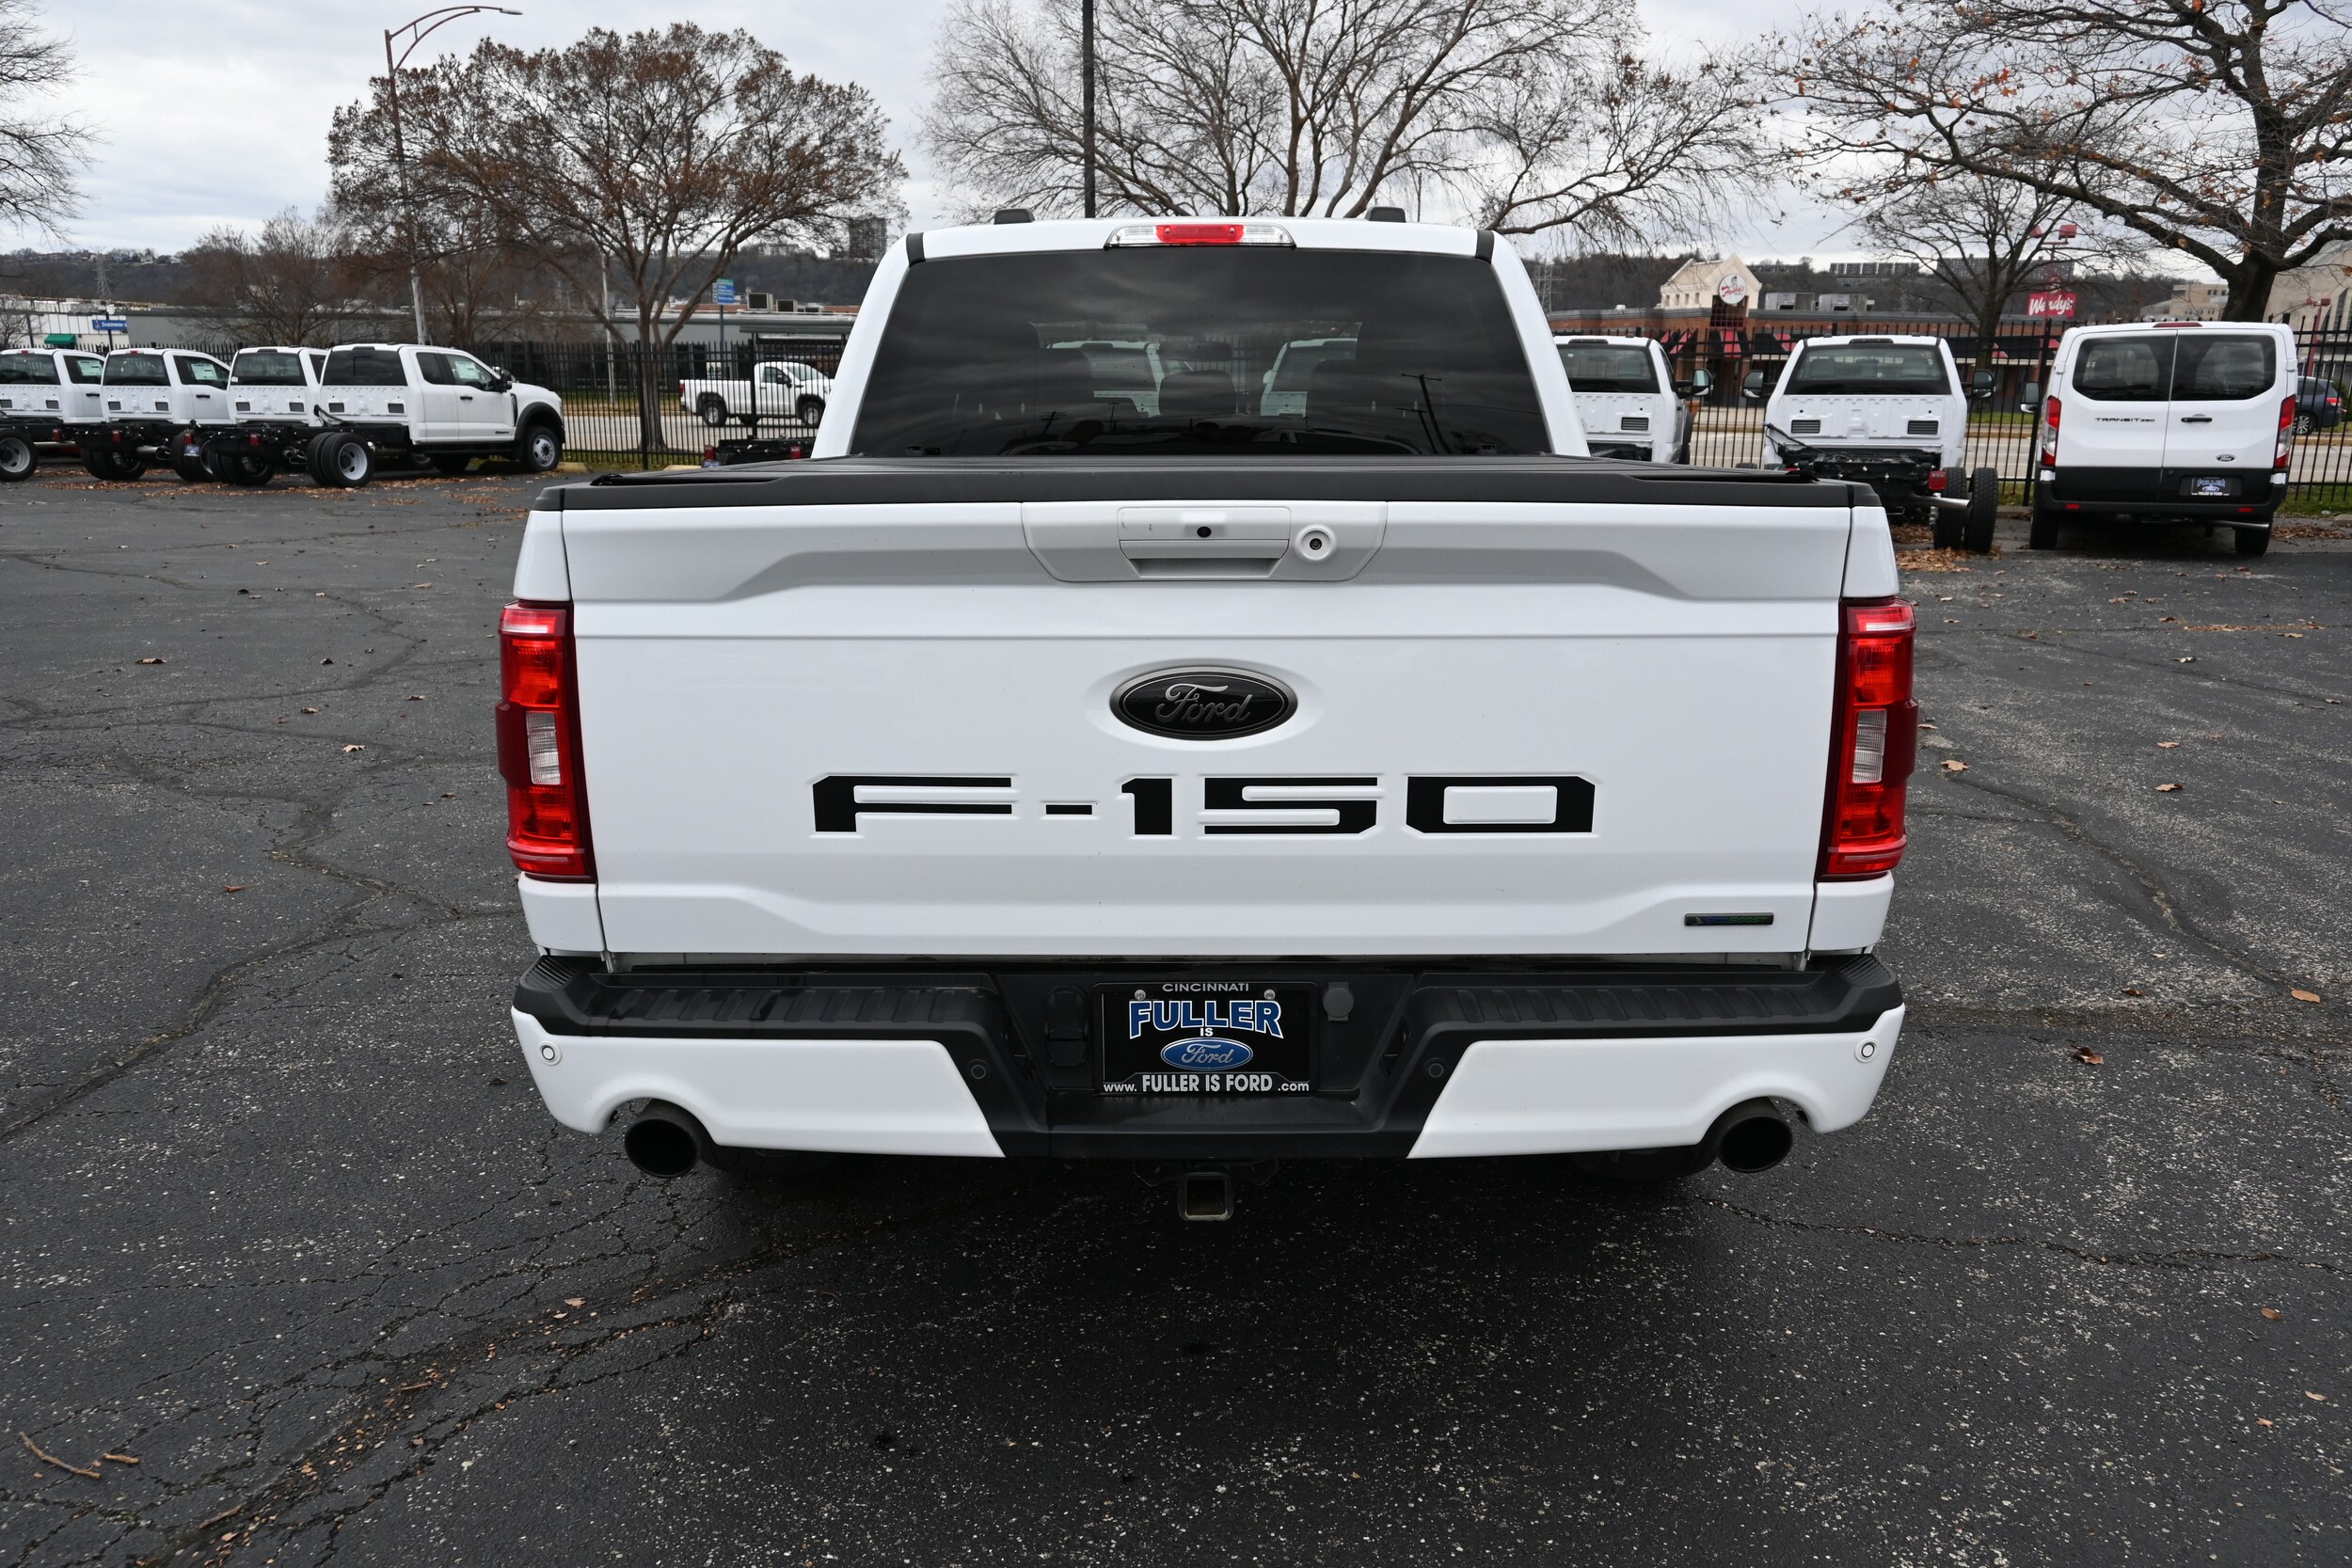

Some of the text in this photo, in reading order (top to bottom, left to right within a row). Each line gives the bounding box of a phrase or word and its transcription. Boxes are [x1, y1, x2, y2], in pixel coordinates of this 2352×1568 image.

[2029, 294, 2074, 316] Wendy's
[1154, 683, 1252, 725] Ford
[812, 774, 1596, 835] F-150
[1162, 983, 1249, 992] CINCINNATI
[1128, 1000, 1284, 1039] FULLER
[1200, 1028, 1214, 1037] IS
[1181, 1043, 1234, 1064] Ford
[1103, 1074, 1309, 1092] www. FULLER IS FORD .com
